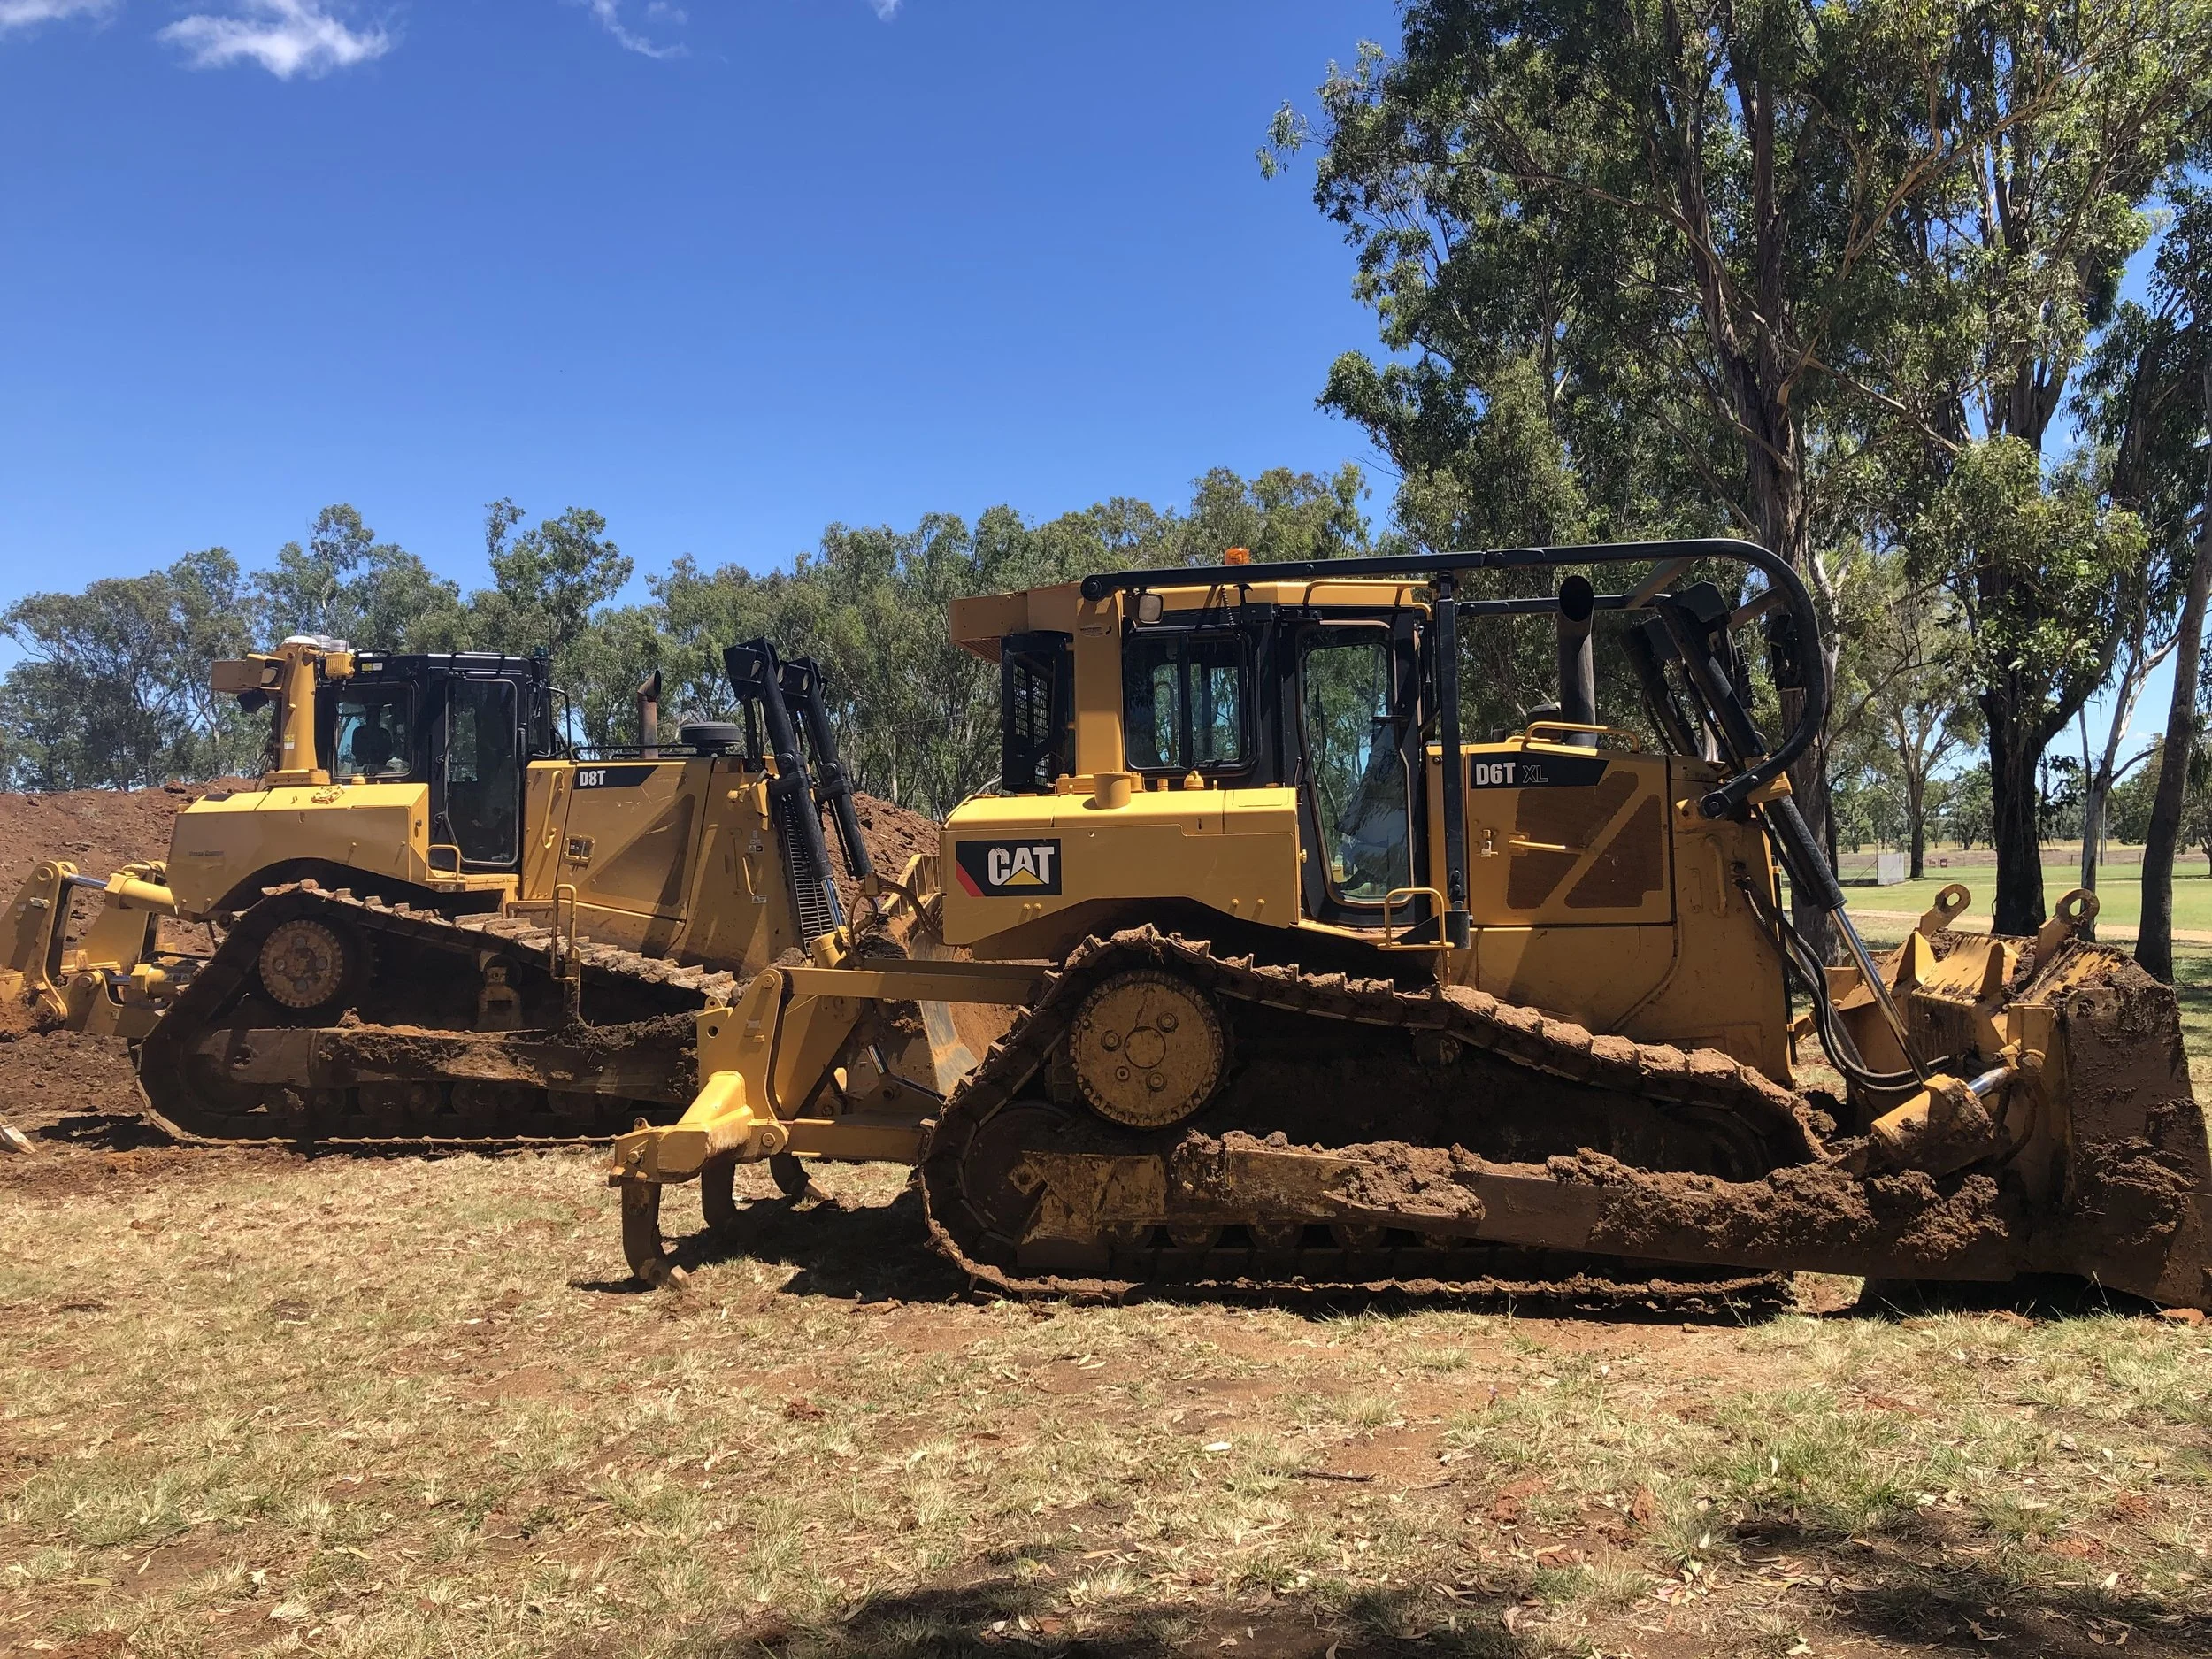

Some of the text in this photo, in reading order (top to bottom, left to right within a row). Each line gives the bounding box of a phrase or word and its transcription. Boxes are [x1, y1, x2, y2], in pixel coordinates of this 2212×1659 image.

[579, 770, 606, 787] D8T
[1475, 762, 1549, 786] D6T XL
[987, 846, 1055, 886] CAT
